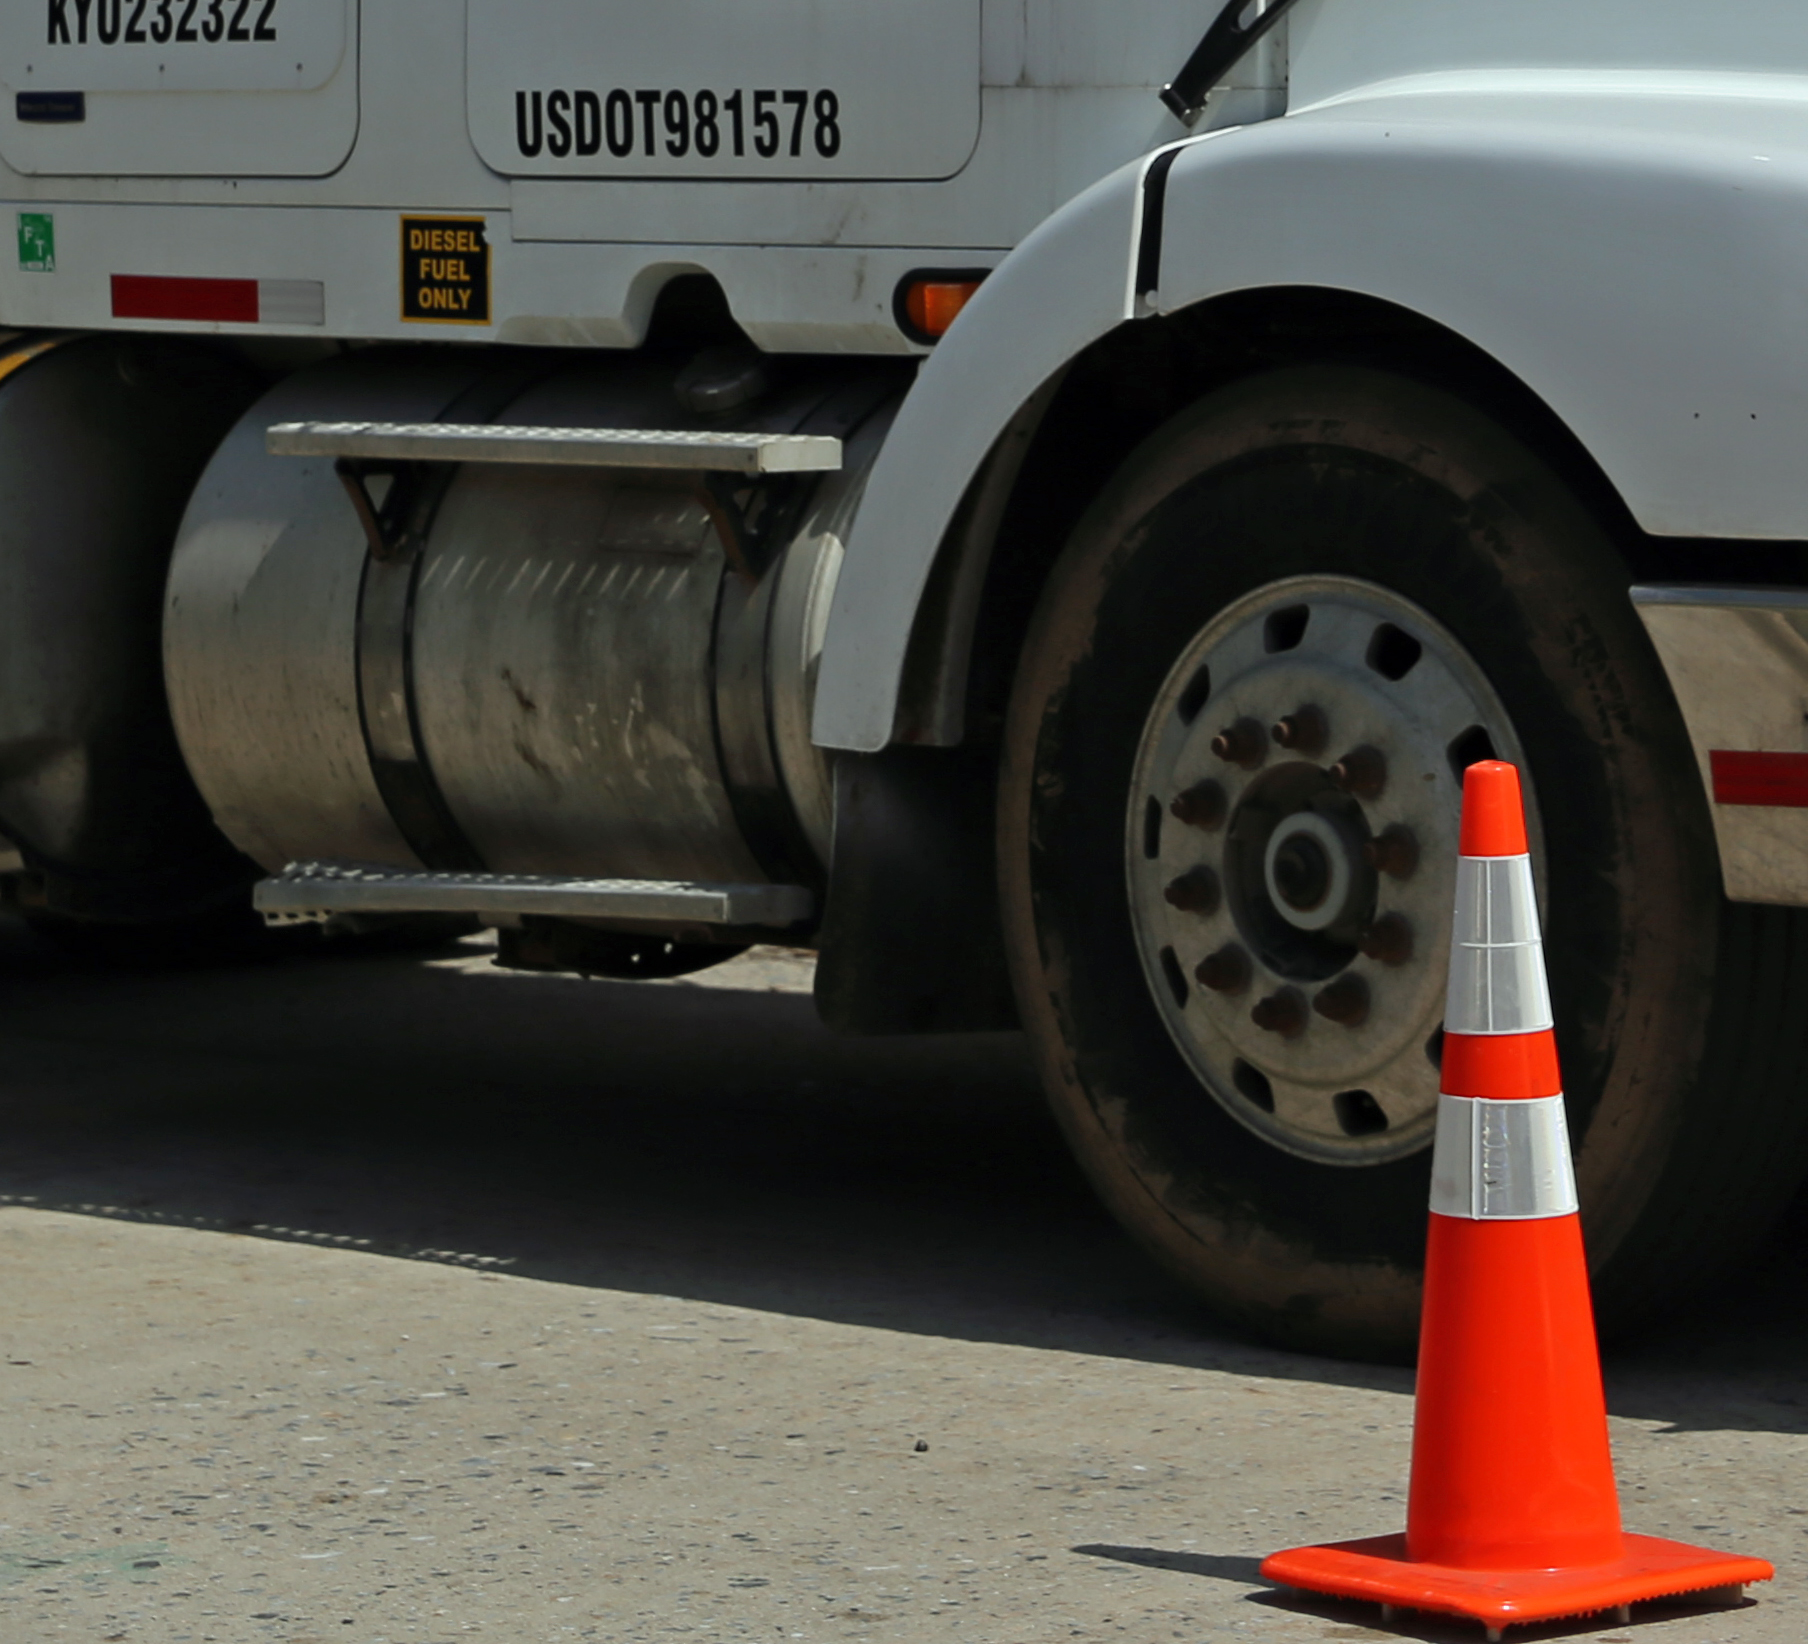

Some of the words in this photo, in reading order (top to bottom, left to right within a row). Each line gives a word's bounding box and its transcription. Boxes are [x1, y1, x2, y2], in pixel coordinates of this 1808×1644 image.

[515, 88, 841, 159] USDOT981578
[410, 228, 481, 253] DIESEL
[420, 258, 471, 281] FUEL
[418, 287, 472, 310] ONLY
